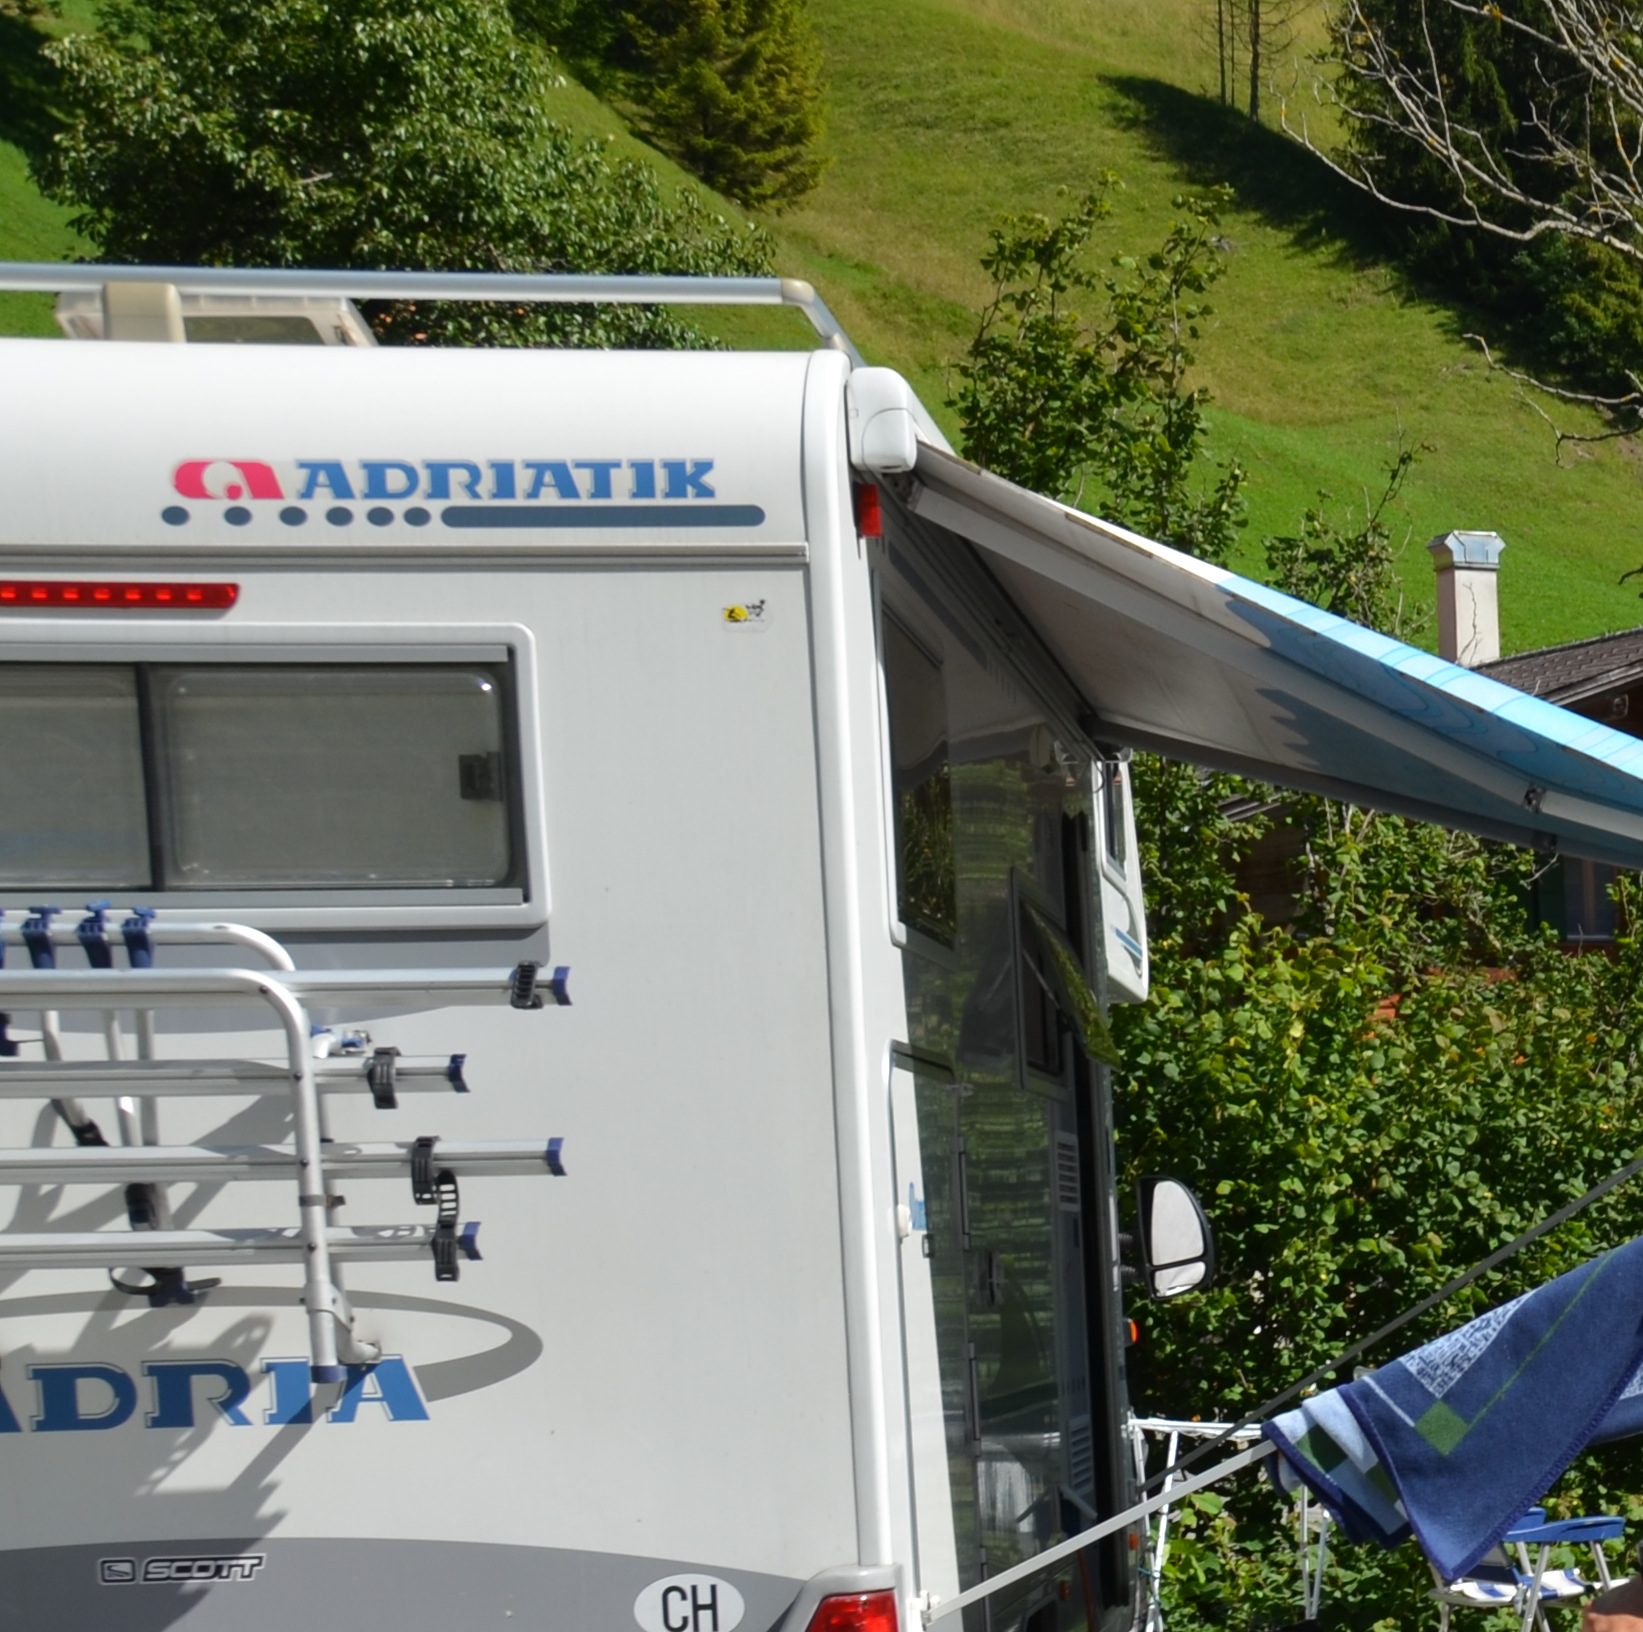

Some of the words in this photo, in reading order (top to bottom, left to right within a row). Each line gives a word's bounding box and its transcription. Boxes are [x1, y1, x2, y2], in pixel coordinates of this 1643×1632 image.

[297, 458, 716, 500] ADRIATIK
[0, 1353, 431, 1433] DRIA
[142, 1554, 266, 1583] SCOTT
